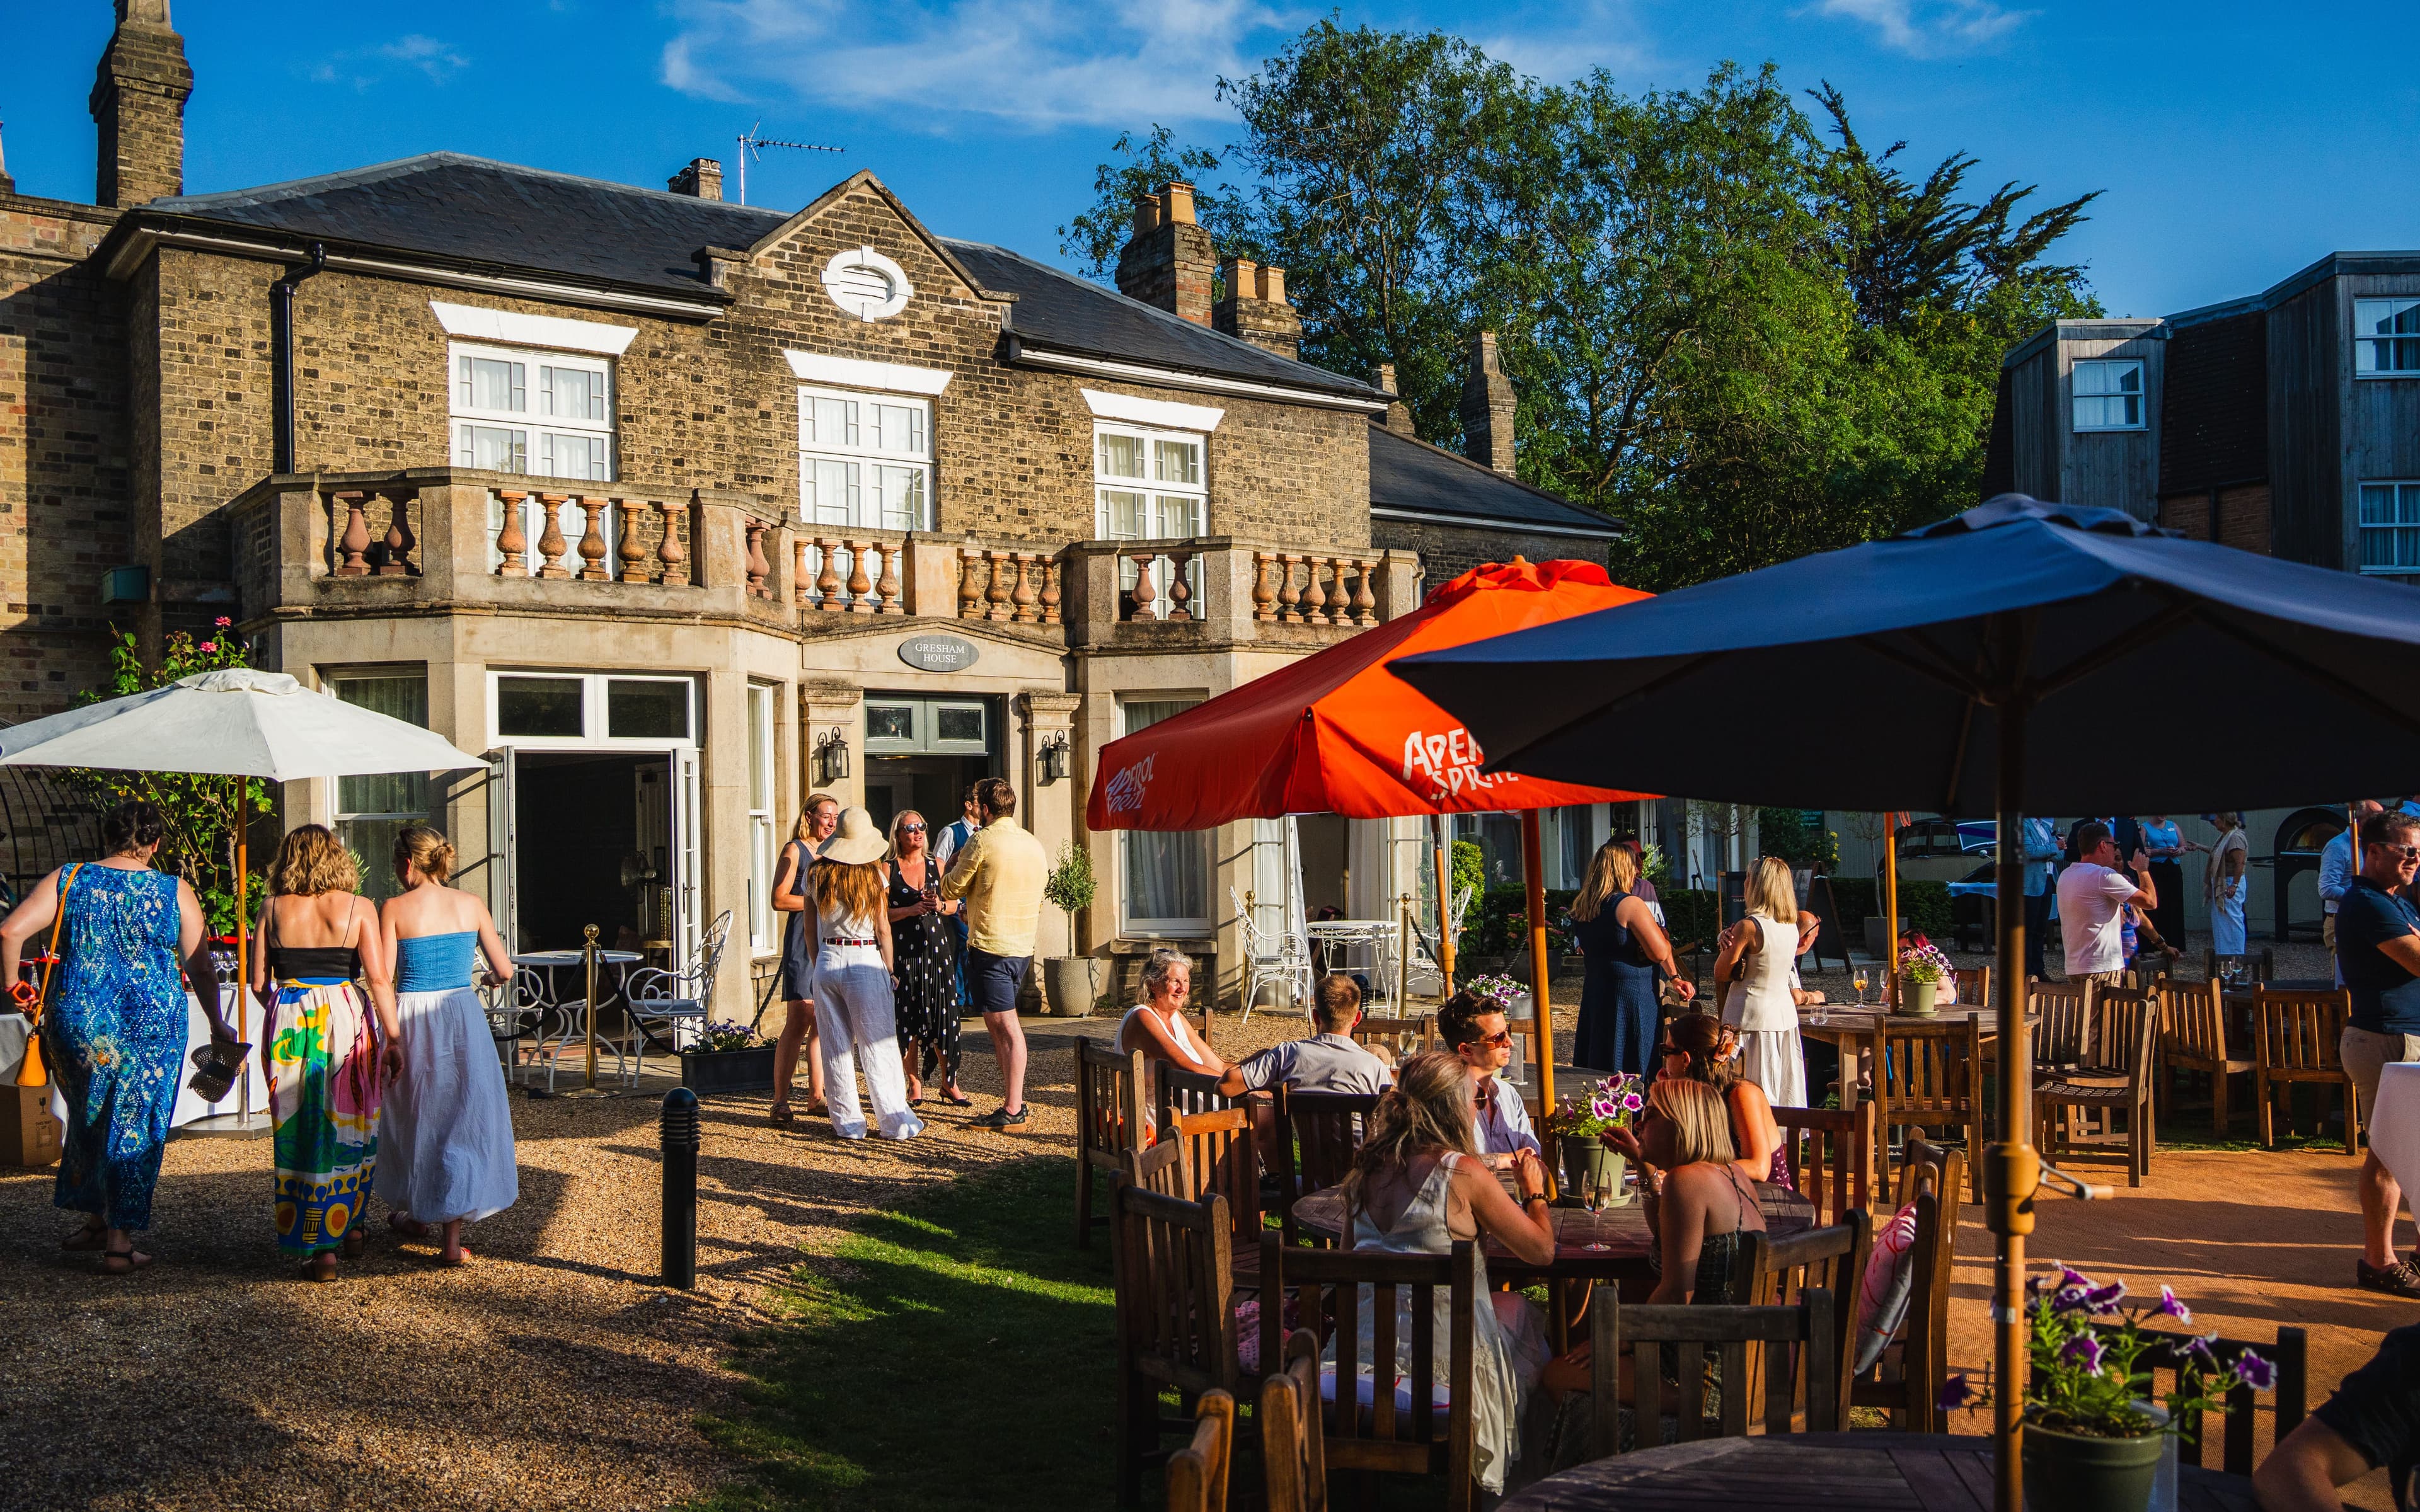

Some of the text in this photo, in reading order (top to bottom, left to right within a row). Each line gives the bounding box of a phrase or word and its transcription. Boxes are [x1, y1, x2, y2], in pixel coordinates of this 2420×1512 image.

[915, 643, 965, 653] GRESHAM
[924, 654, 957, 663] HOUSE
[1105, 752, 1156, 796] APEROL
